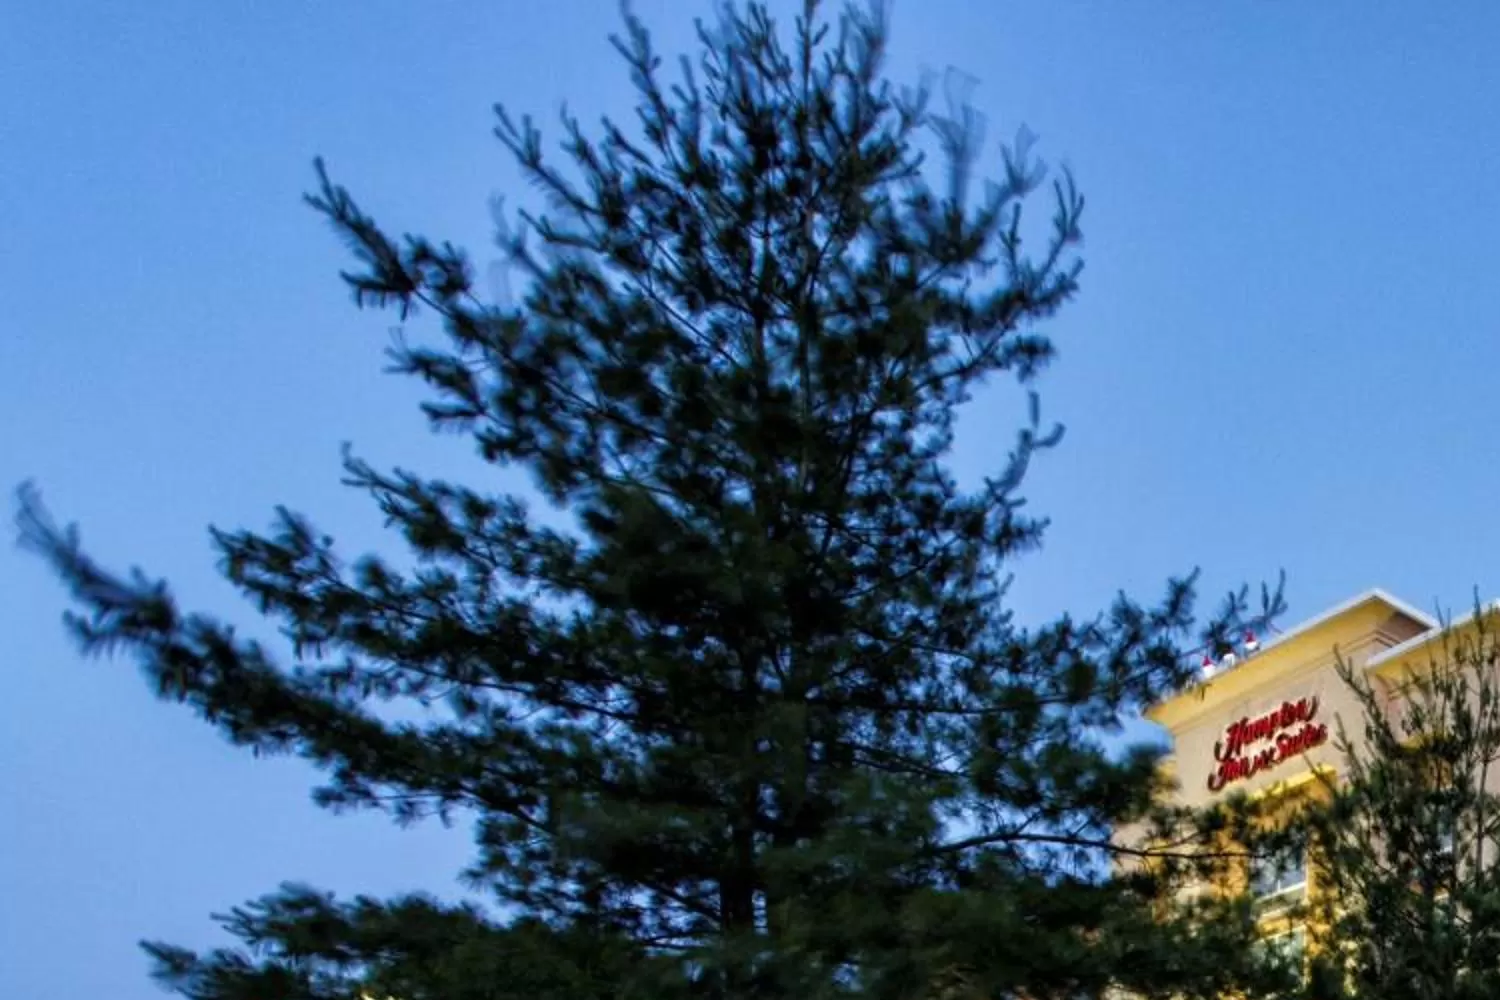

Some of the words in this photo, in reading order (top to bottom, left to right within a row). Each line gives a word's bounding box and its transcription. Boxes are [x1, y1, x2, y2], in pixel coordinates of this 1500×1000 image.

[1207, 756, 1257, 792] Inn
[1275, 723, 1328, 764] Suites
[1213, 695, 1319, 762] Hampton
